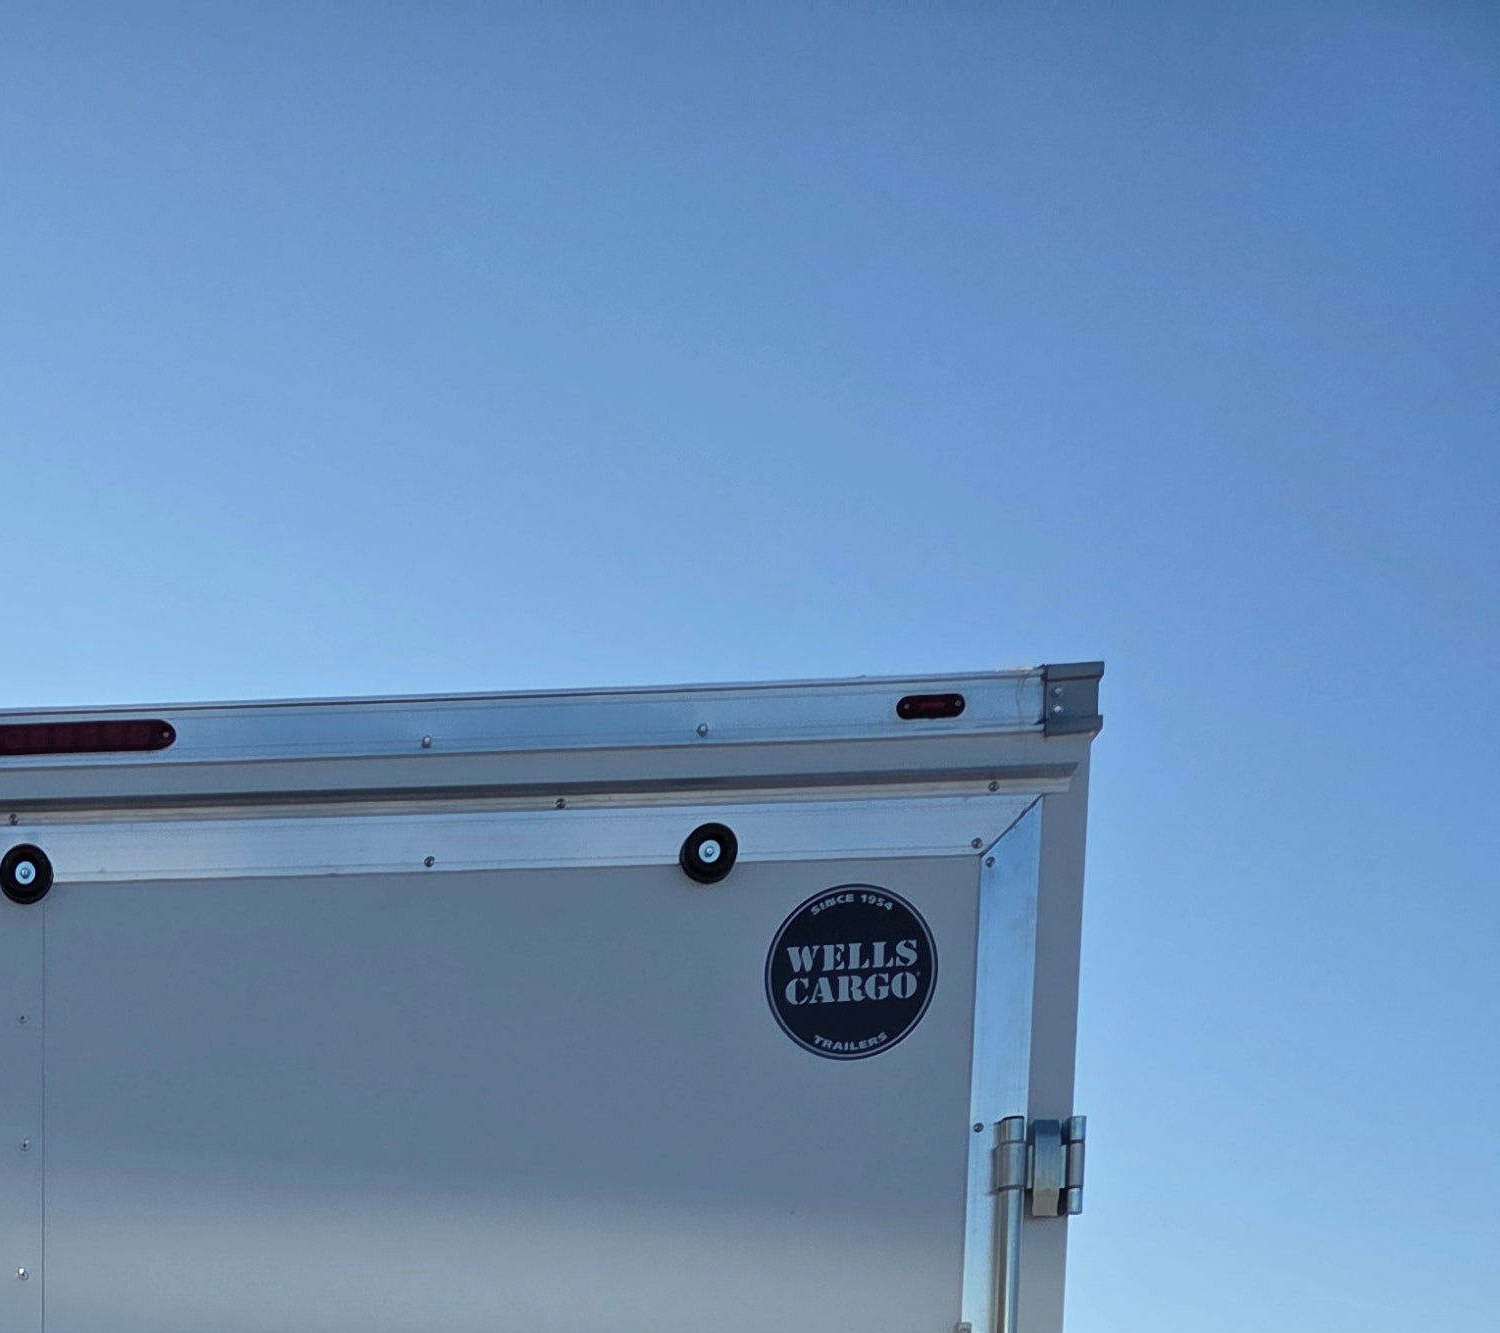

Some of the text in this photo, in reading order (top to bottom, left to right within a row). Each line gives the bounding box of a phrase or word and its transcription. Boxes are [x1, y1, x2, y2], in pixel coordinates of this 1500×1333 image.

[810, 893, 893, 916] SINCE 1954
[786, 939, 918, 973] WELLS
[785, 971, 918, 1005] CARGO
[813, 1031, 888, 1051] TRAILERS
